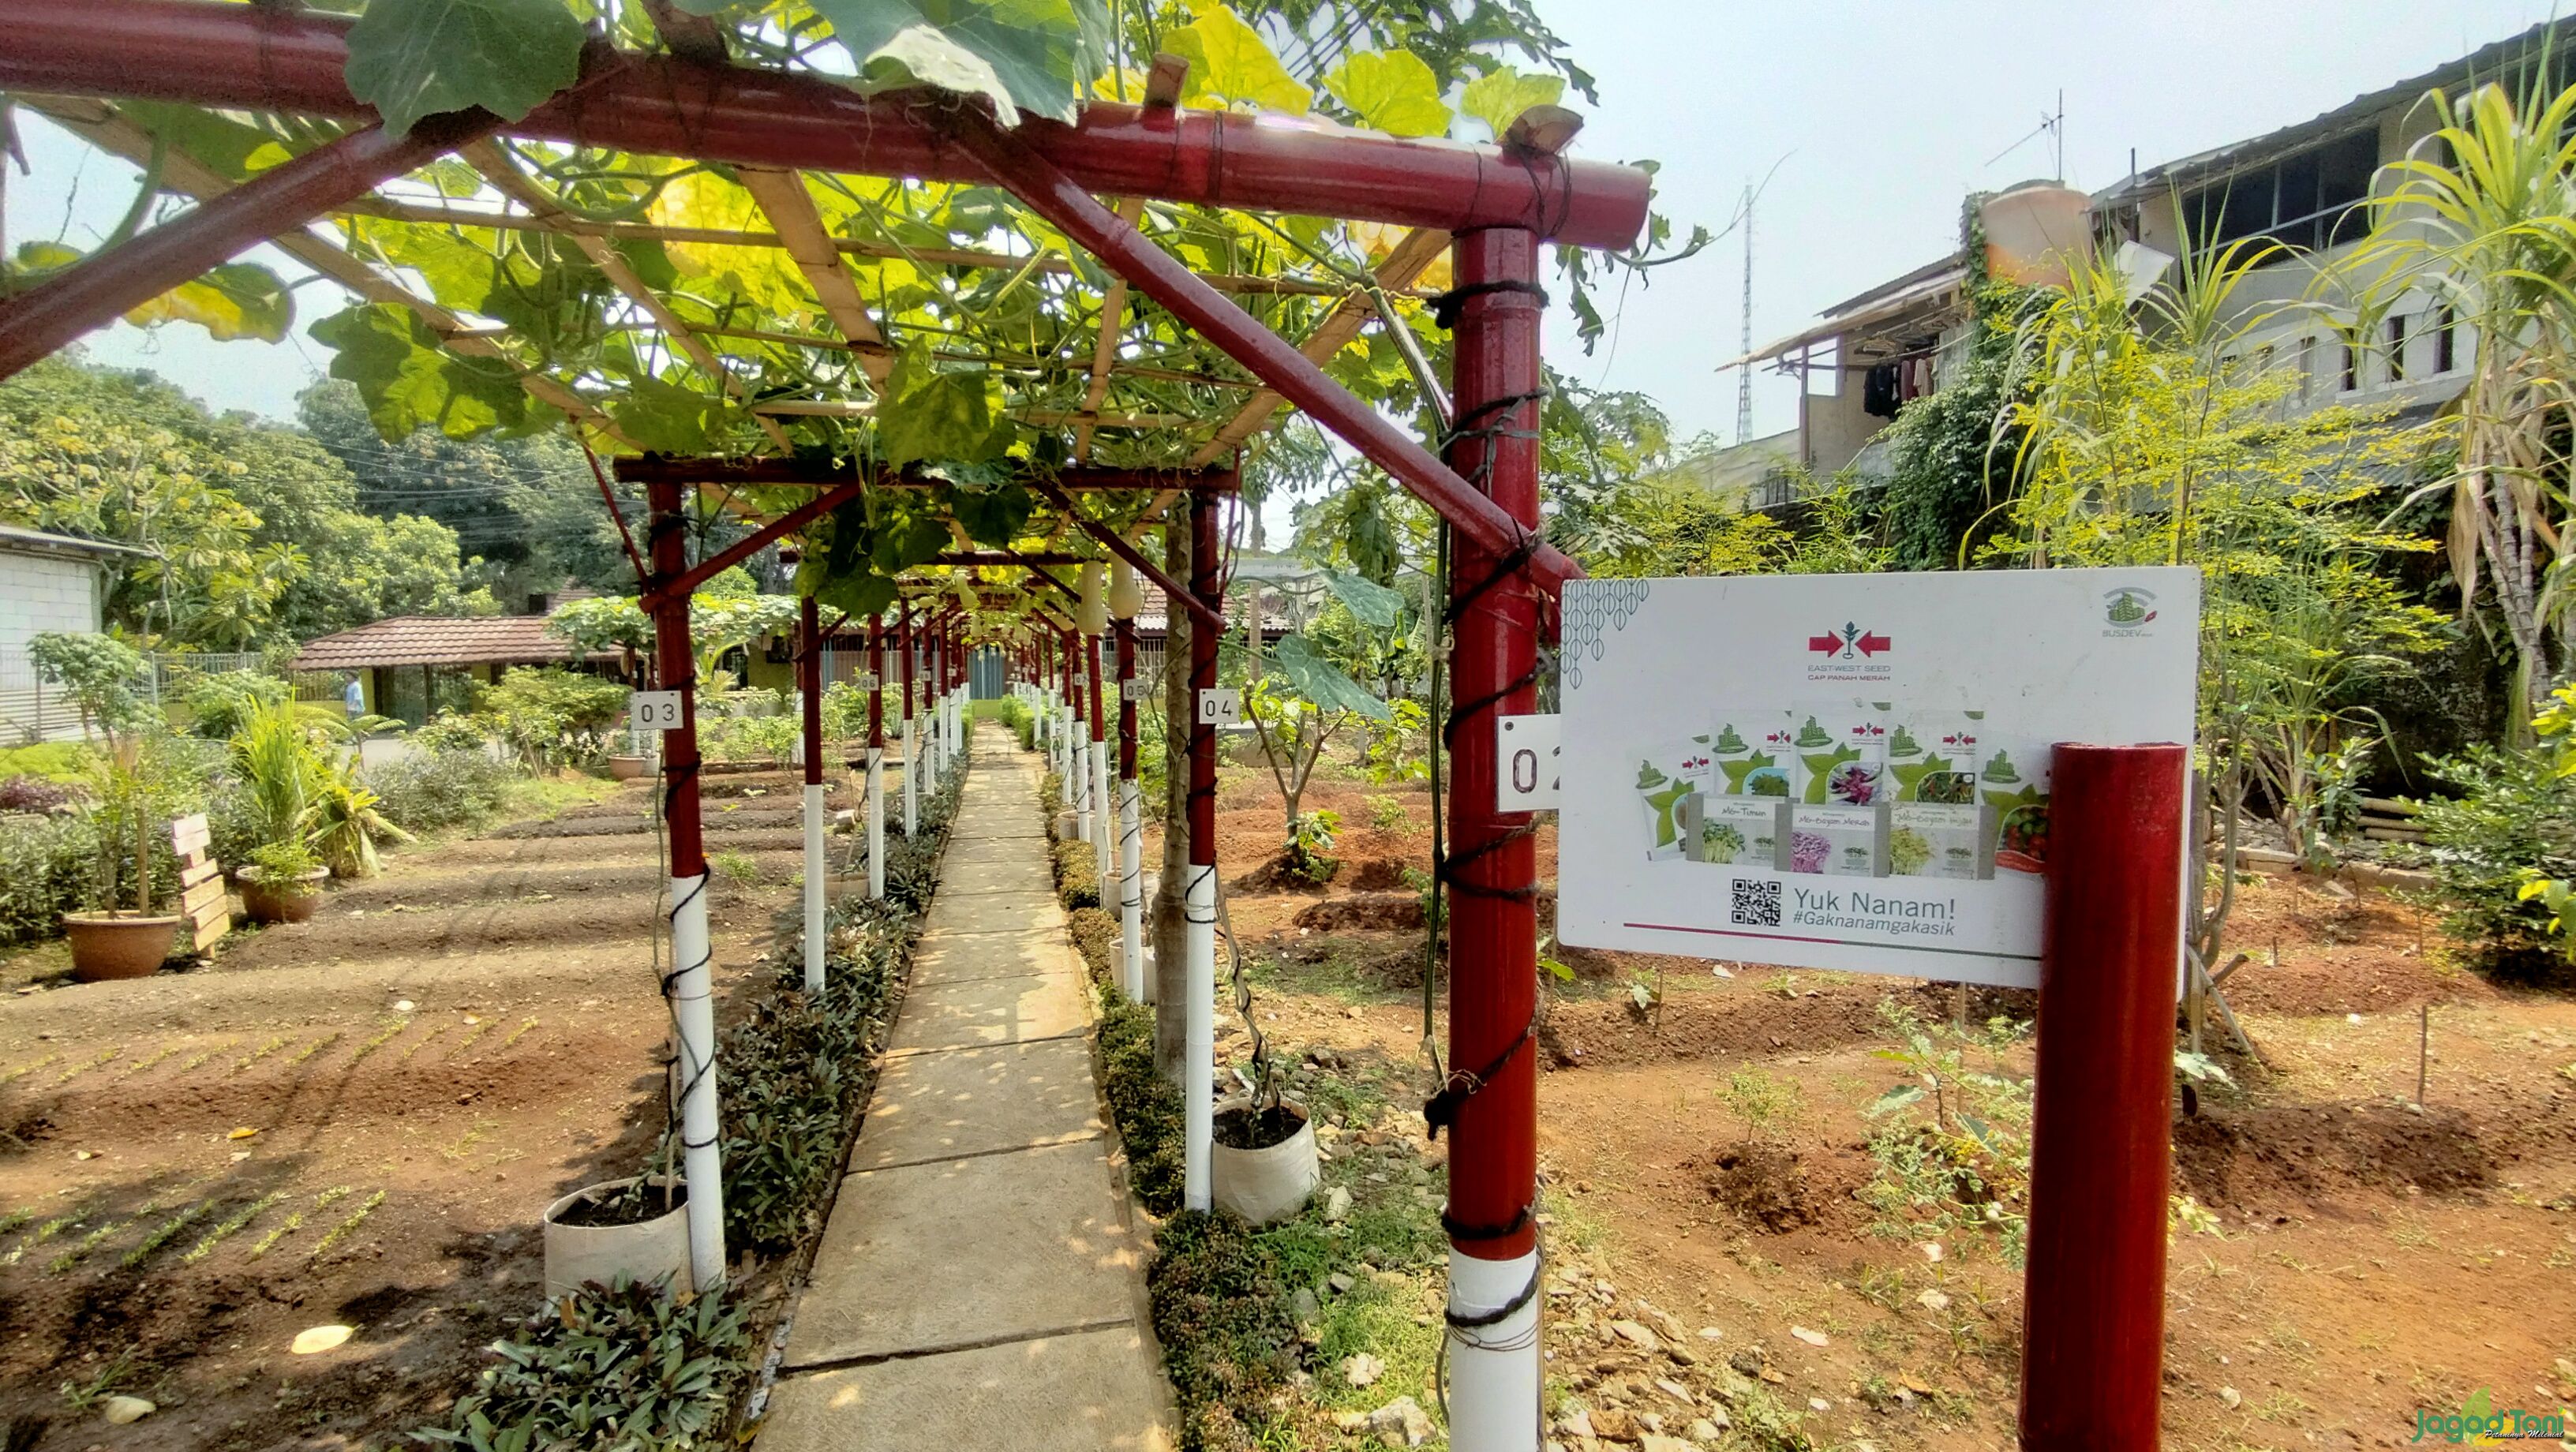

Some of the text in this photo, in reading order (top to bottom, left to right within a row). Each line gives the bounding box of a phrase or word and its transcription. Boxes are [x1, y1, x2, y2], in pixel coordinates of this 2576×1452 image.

[2102, 629, 2142, 638] BUSDEV
[862, 679, 875, 687] 06
[1127, 685, 1144, 696] 05
[641, 703, 675, 723] 03
[1205, 699, 1232, 717] 04
[1794, 888, 1955, 920] Yuk Nanam!
[1792, 911, 1956, 936] #Gaknanamgakasik
